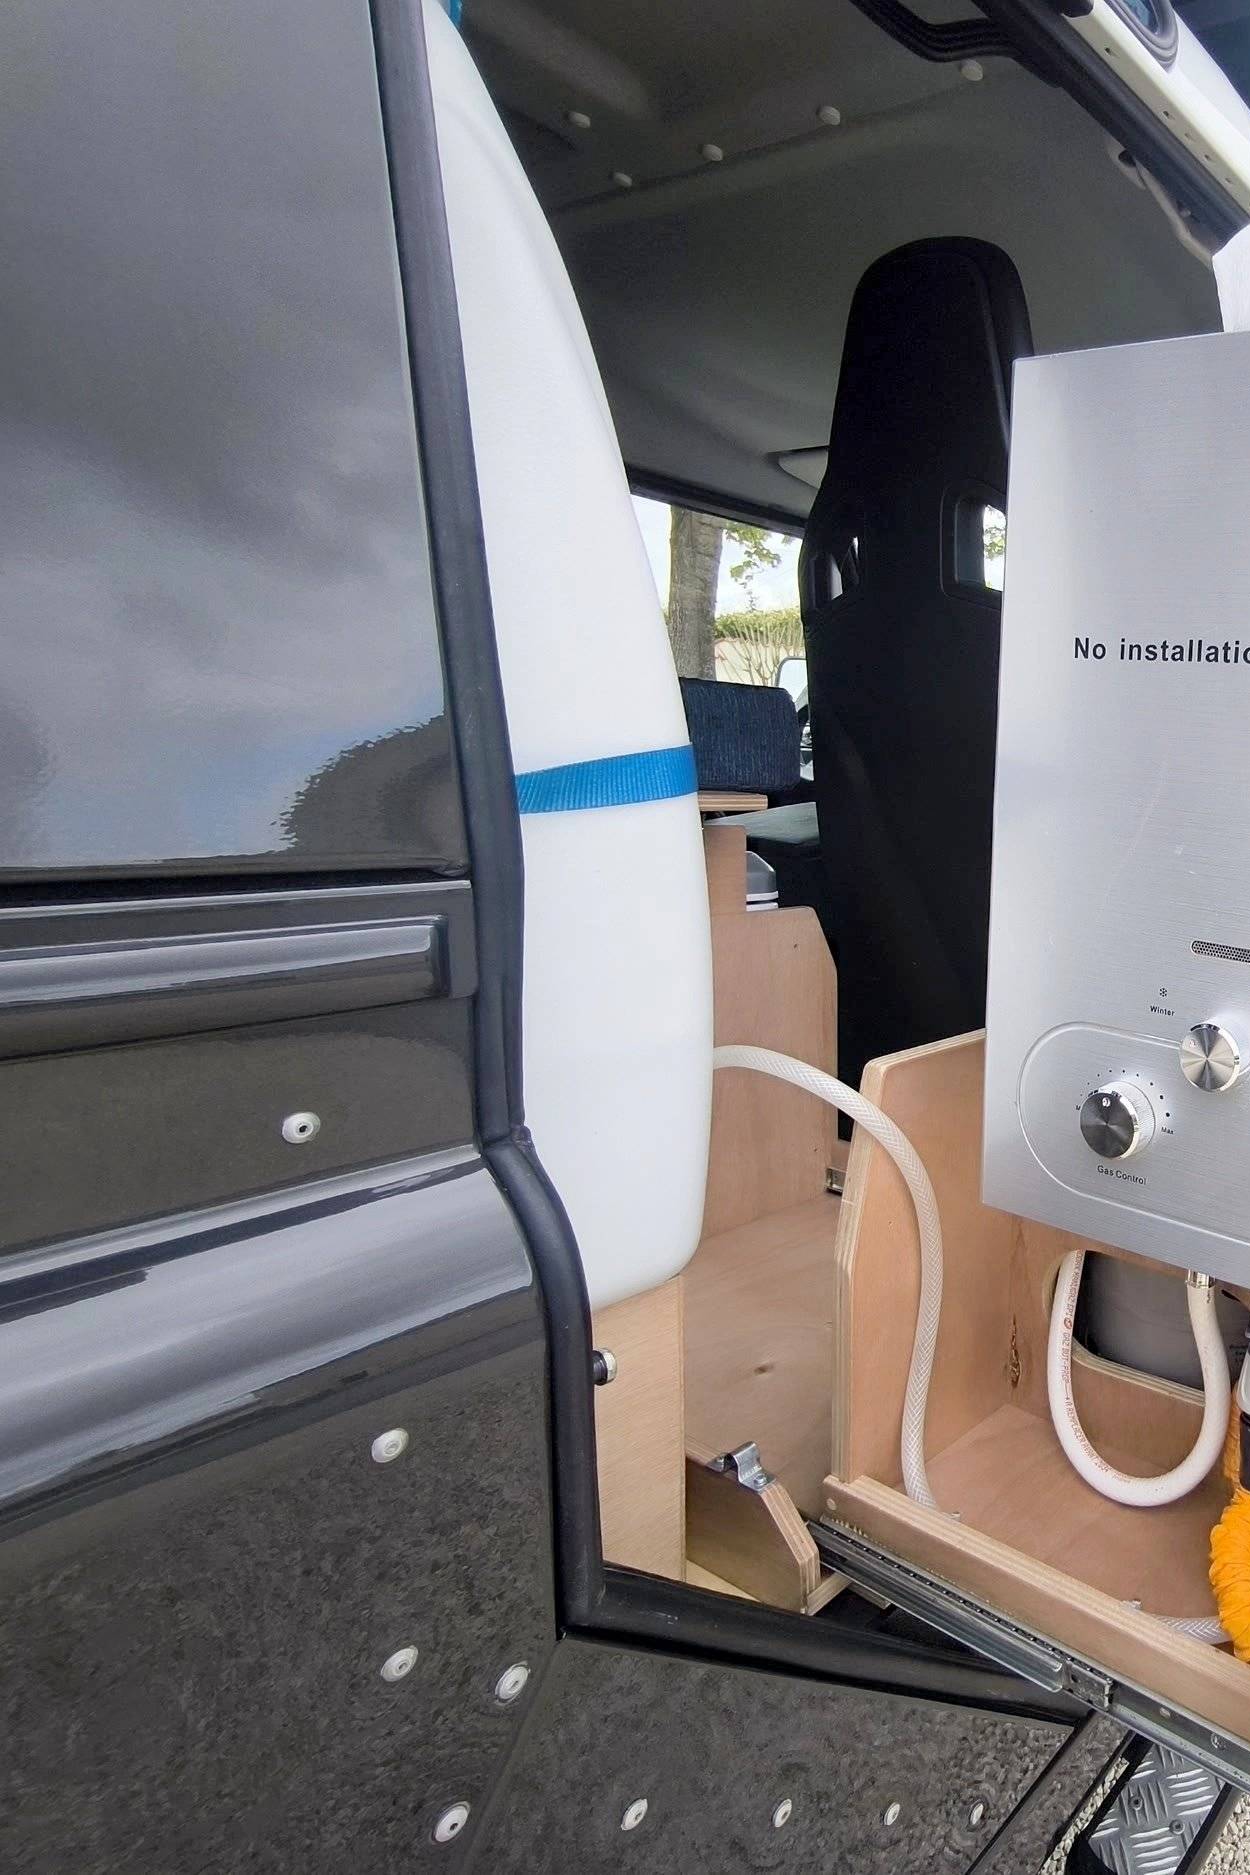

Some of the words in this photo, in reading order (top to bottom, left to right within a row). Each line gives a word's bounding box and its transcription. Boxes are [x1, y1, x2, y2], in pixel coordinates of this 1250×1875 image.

[1074, 637, 1107, 660] No
[1150, 1005, 1176, 1018] Winter
[1161, 1126, 1175, 1135] Max
[1097, 1164, 1115, 1176] Gas
[1115, 1170, 1148, 1186] Control
